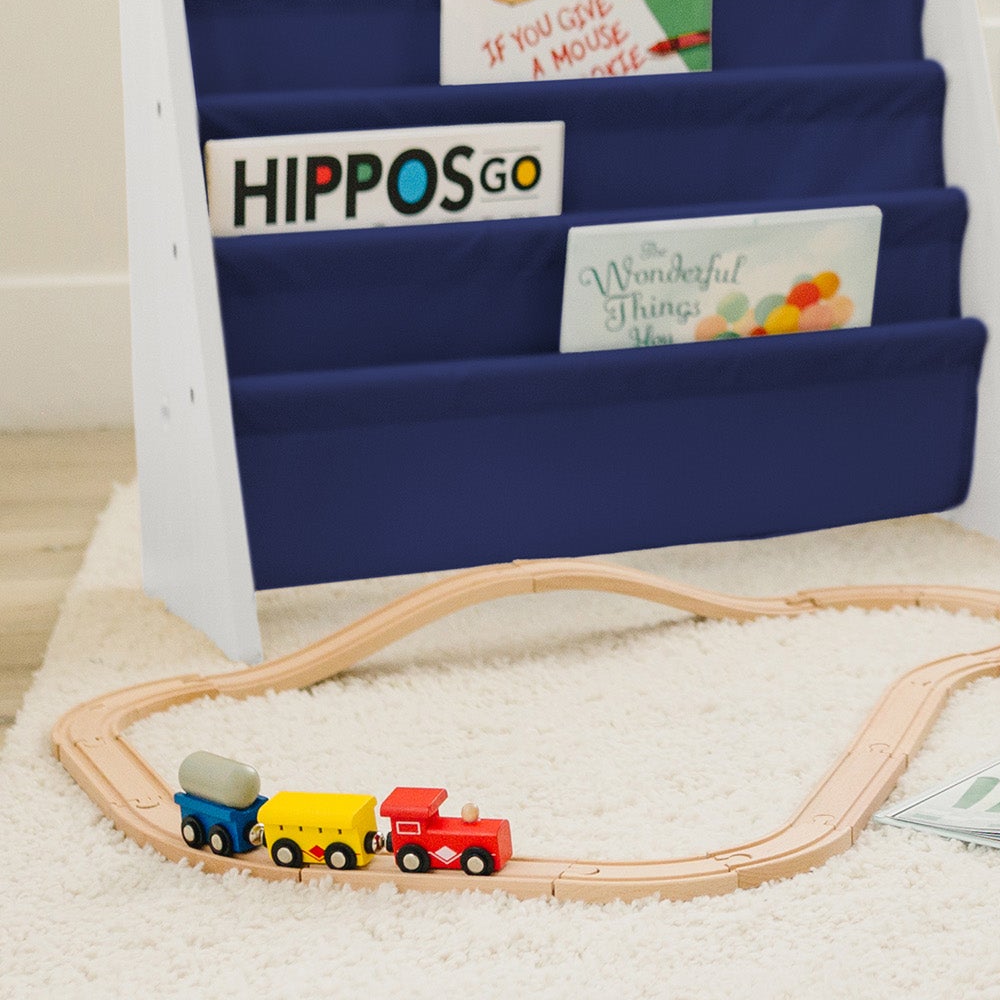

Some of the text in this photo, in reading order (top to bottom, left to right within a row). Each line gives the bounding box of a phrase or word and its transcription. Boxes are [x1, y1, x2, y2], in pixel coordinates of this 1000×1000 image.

[482, 34, 506, 69] IF
[510, 13, 553, 53] YOU
[532, 20, 631, 80] A MOUSE
[233, 145, 542, 228] HIPPOS GO
[578, 251, 747, 296] Wonderful
[603, 290, 701, 333] Things
